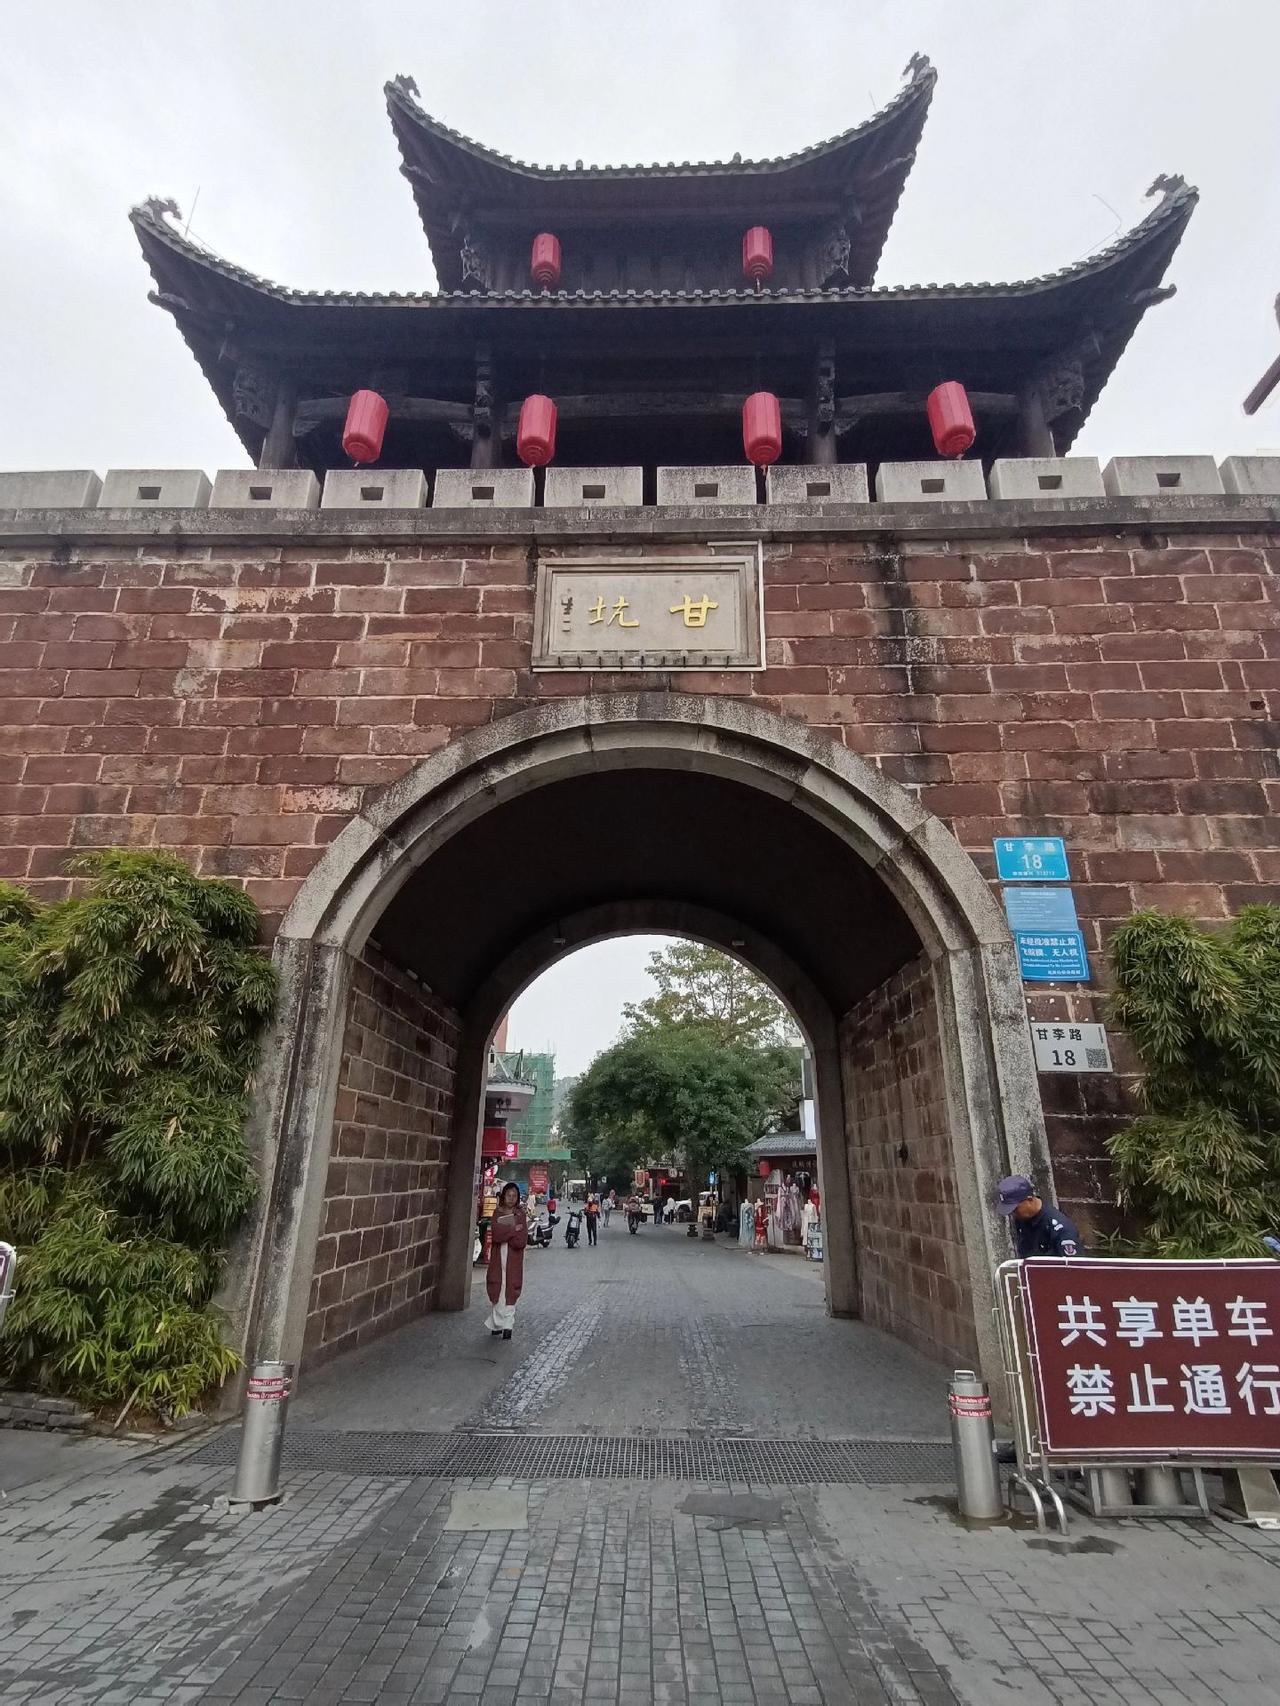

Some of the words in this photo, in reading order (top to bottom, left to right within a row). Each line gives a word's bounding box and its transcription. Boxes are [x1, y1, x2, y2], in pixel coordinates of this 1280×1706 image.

[588, 593, 719, 627] 甘坑
[1021, 854, 1042, 869] 18
[1035, 1028, 1082, 1041] 甘李路
[1052, 1049, 1076, 1066] 18
[1057, 1295, 1274, 1348] 共享单车
[1066, 1362, 1280, 1417] 禁止通行
